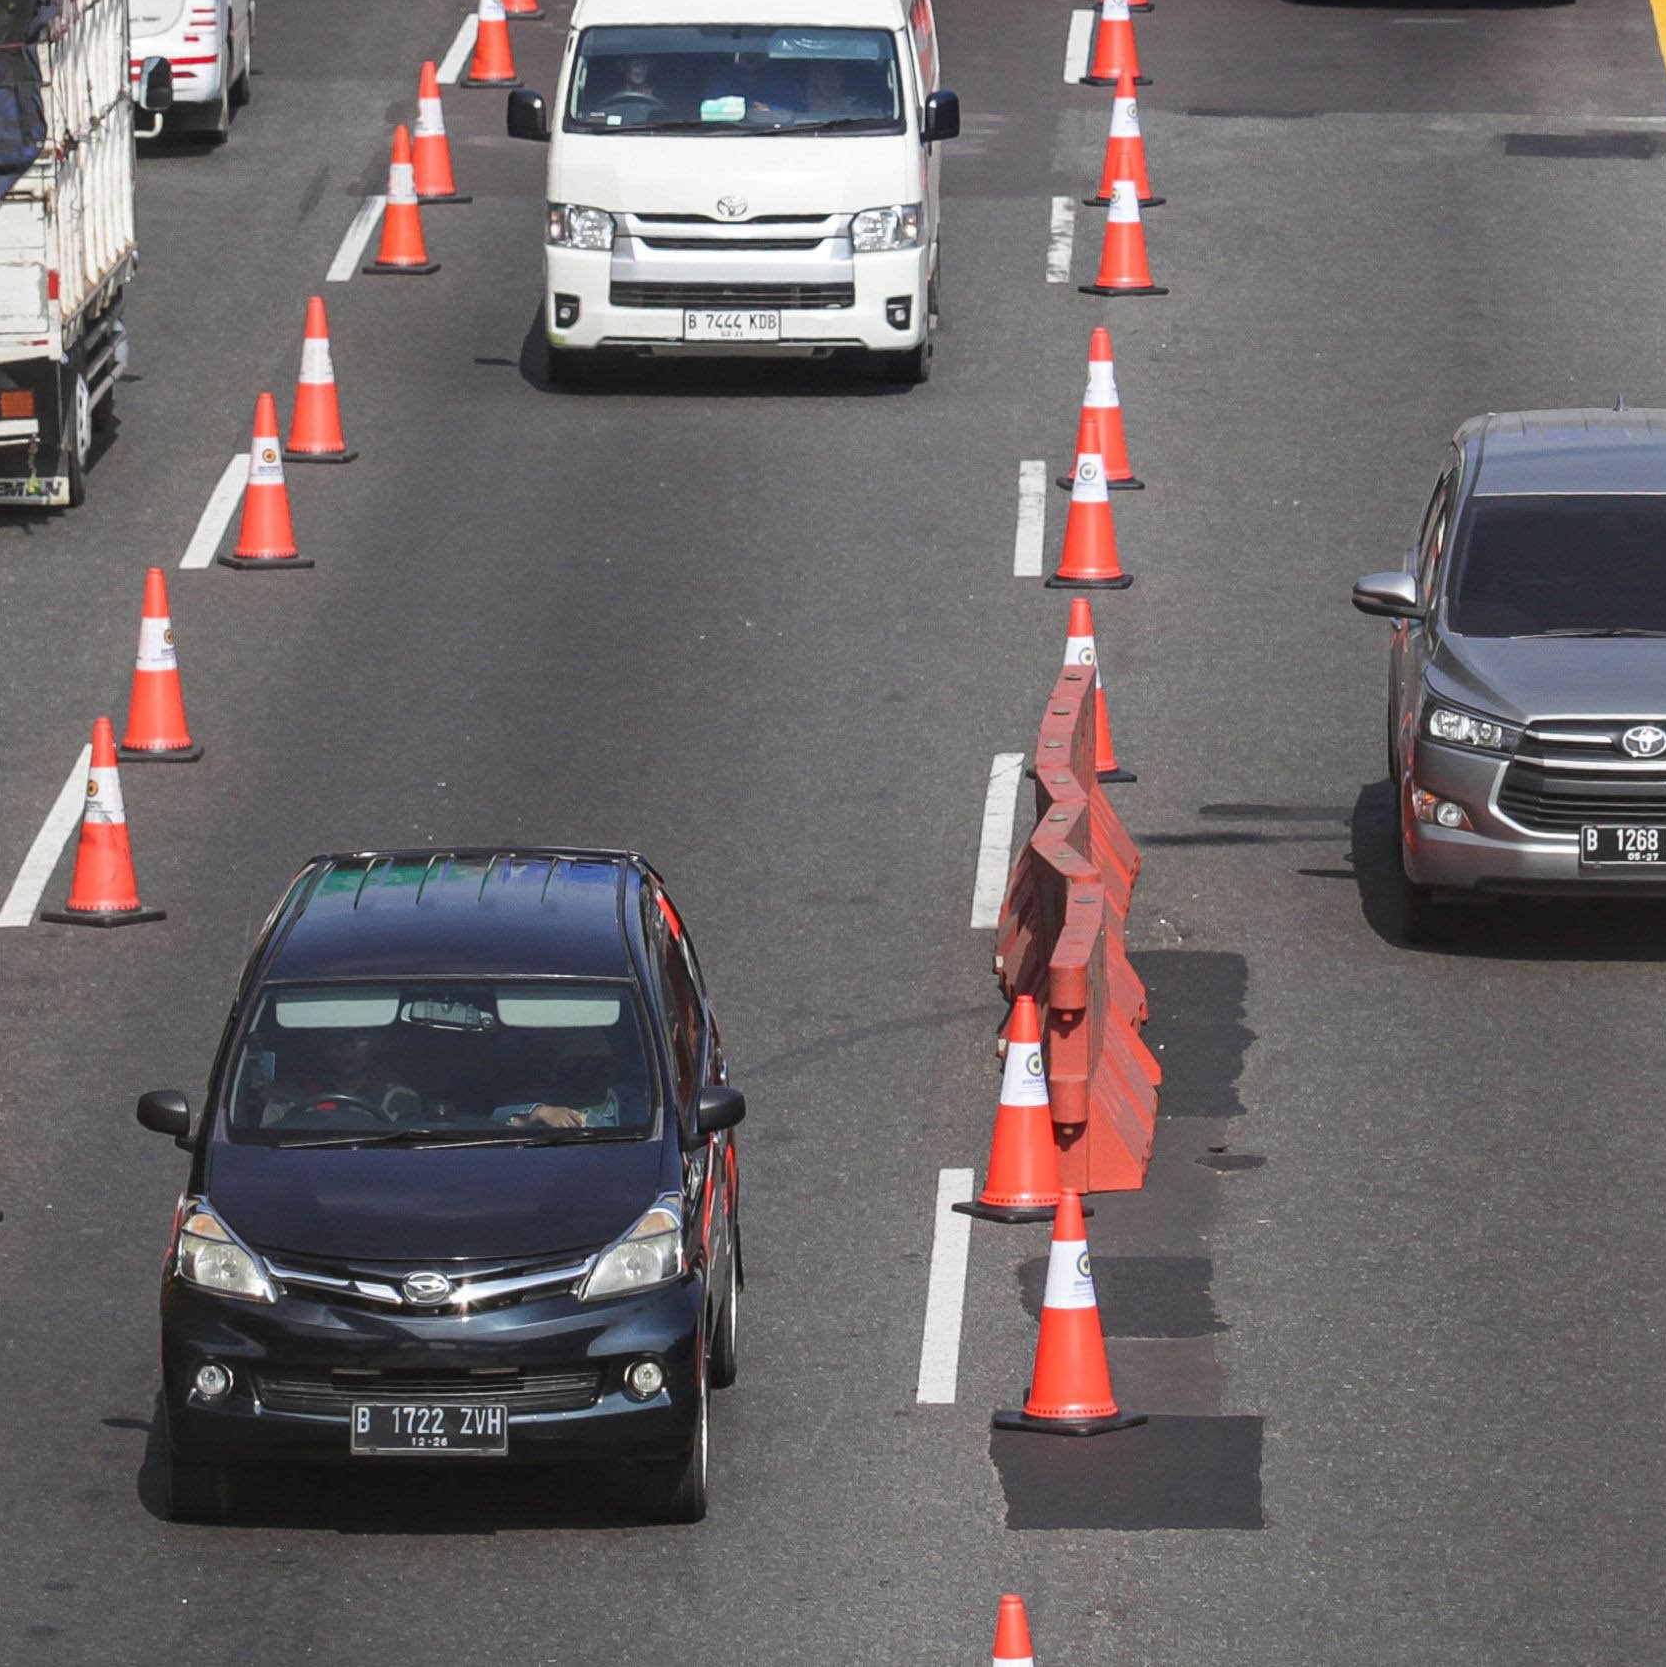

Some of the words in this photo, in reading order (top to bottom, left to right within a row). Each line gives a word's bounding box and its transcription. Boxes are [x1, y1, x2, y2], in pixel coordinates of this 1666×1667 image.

[688, 314, 697, 329] B
[706, 313, 742, 329] 7444
[749, 313, 777, 329] KDB
[1585, 828, 1598, 852] B
[1617, 829, 1658, 852] 1268
[356, 1406, 371, 1434] B
[391, 1406, 445, 1434] 1722
[459, 1406, 503, 1435] ZVH
